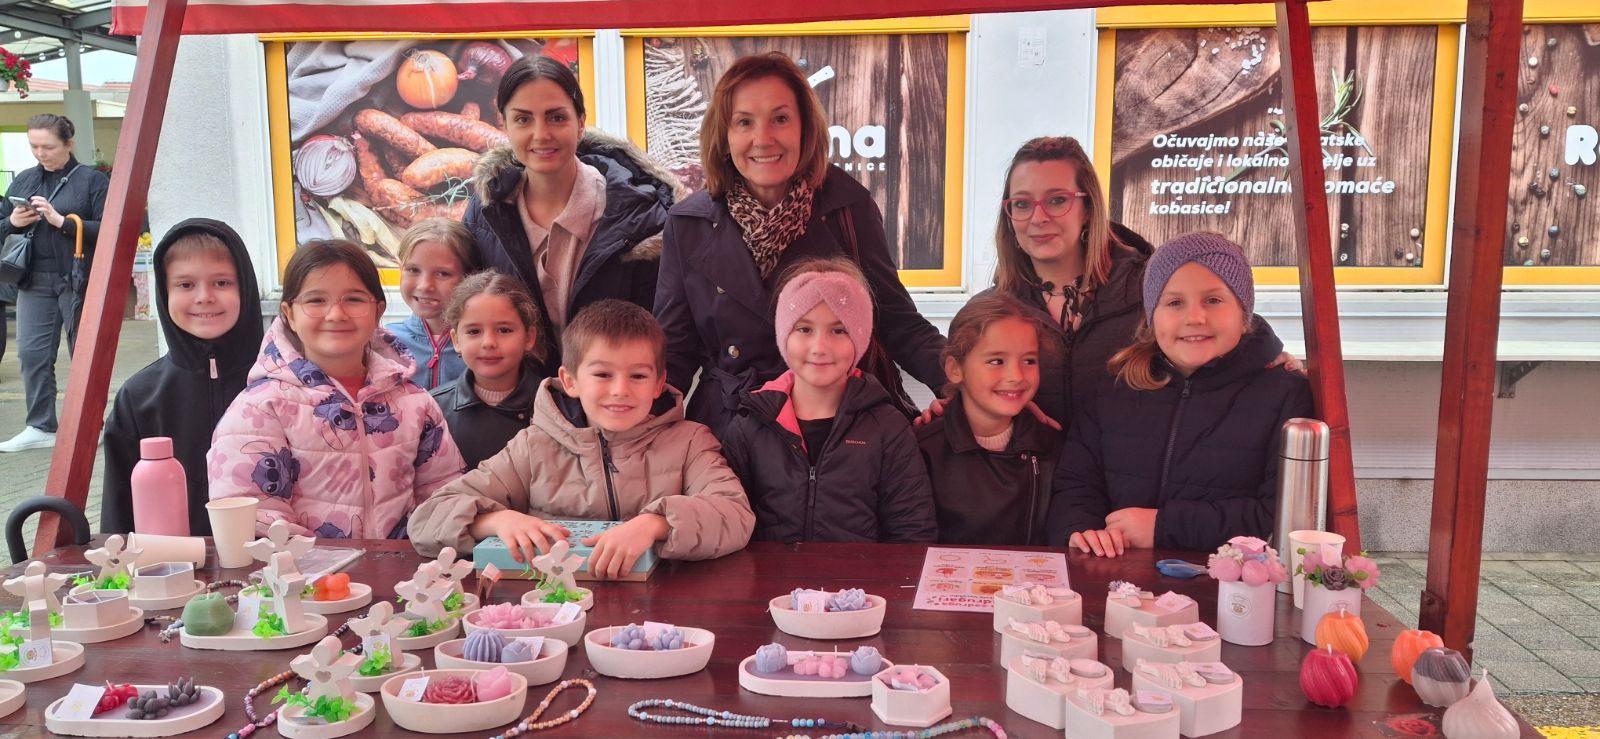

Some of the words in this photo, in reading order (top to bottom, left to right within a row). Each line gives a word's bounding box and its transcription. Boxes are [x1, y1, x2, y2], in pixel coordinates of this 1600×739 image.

[828, 125, 886, 158] na
[1152, 133, 1239, 151] Očuvajmo
[1242, 132, 1285, 147] naše
[1320, 133, 1365, 147] atske
[1565, 124, 1600, 166] R
[833, 162, 887, 171] NICE
[1151, 154, 1214, 171] običaje
[1217, 154, 1224, 168] i
[1226, 154, 1290, 168] lokalno
[1356, 157, 1377, 167] uz
[1150, 176, 1292, 195] tradicionaln
[1324, 176, 1396, 194] omaće
[1149, 200, 1231, 215] kobasice!
